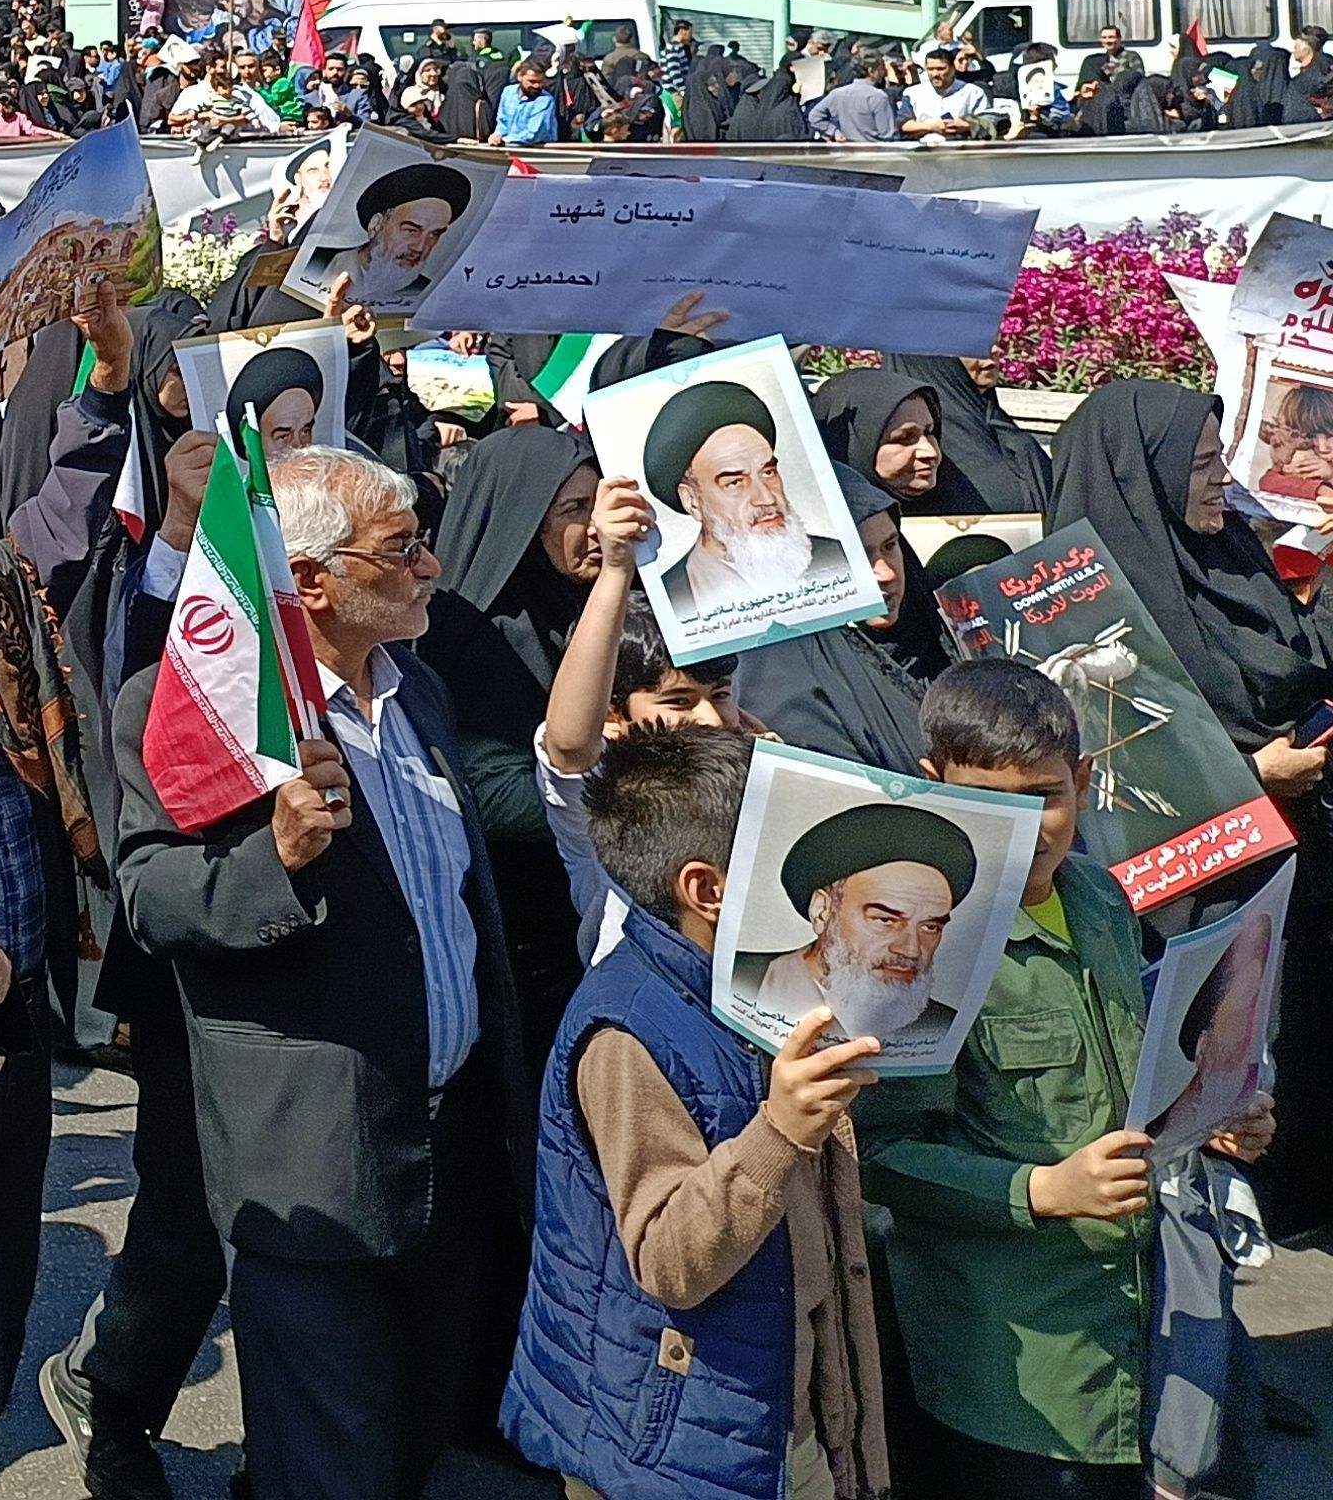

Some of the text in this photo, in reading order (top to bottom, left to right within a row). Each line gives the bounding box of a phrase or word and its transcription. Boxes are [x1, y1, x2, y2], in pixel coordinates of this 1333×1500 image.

[549, 199, 694, 227] دبستان شهید
[463, 266, 475, 283] ۲
[1294, 272, 1333, 312] زه
[1000, 546, 1095, 597] مرگ بر آمریکا
[680, 573, 852, 625] امام بزرگوار روح جمهوری اسلامی است
[1012, 589, 1049, 611] DOWN
[1046, 575, 1076, 595] WITH
[1070, 572, 1112, 603] الموت
[1121, 813, 1253, 885] مردم غزه مورد ظلم کسانی
[1223, 837, 1248, 859] هیچ
[1248, 826, 1263, 843] که
[1144, 862, 1188, 893] انسانیت
[1187, 856, 1199, 878] از
[733, 991, 757, 1010] است
[756, 1008, 801, 1028] اسلامی
